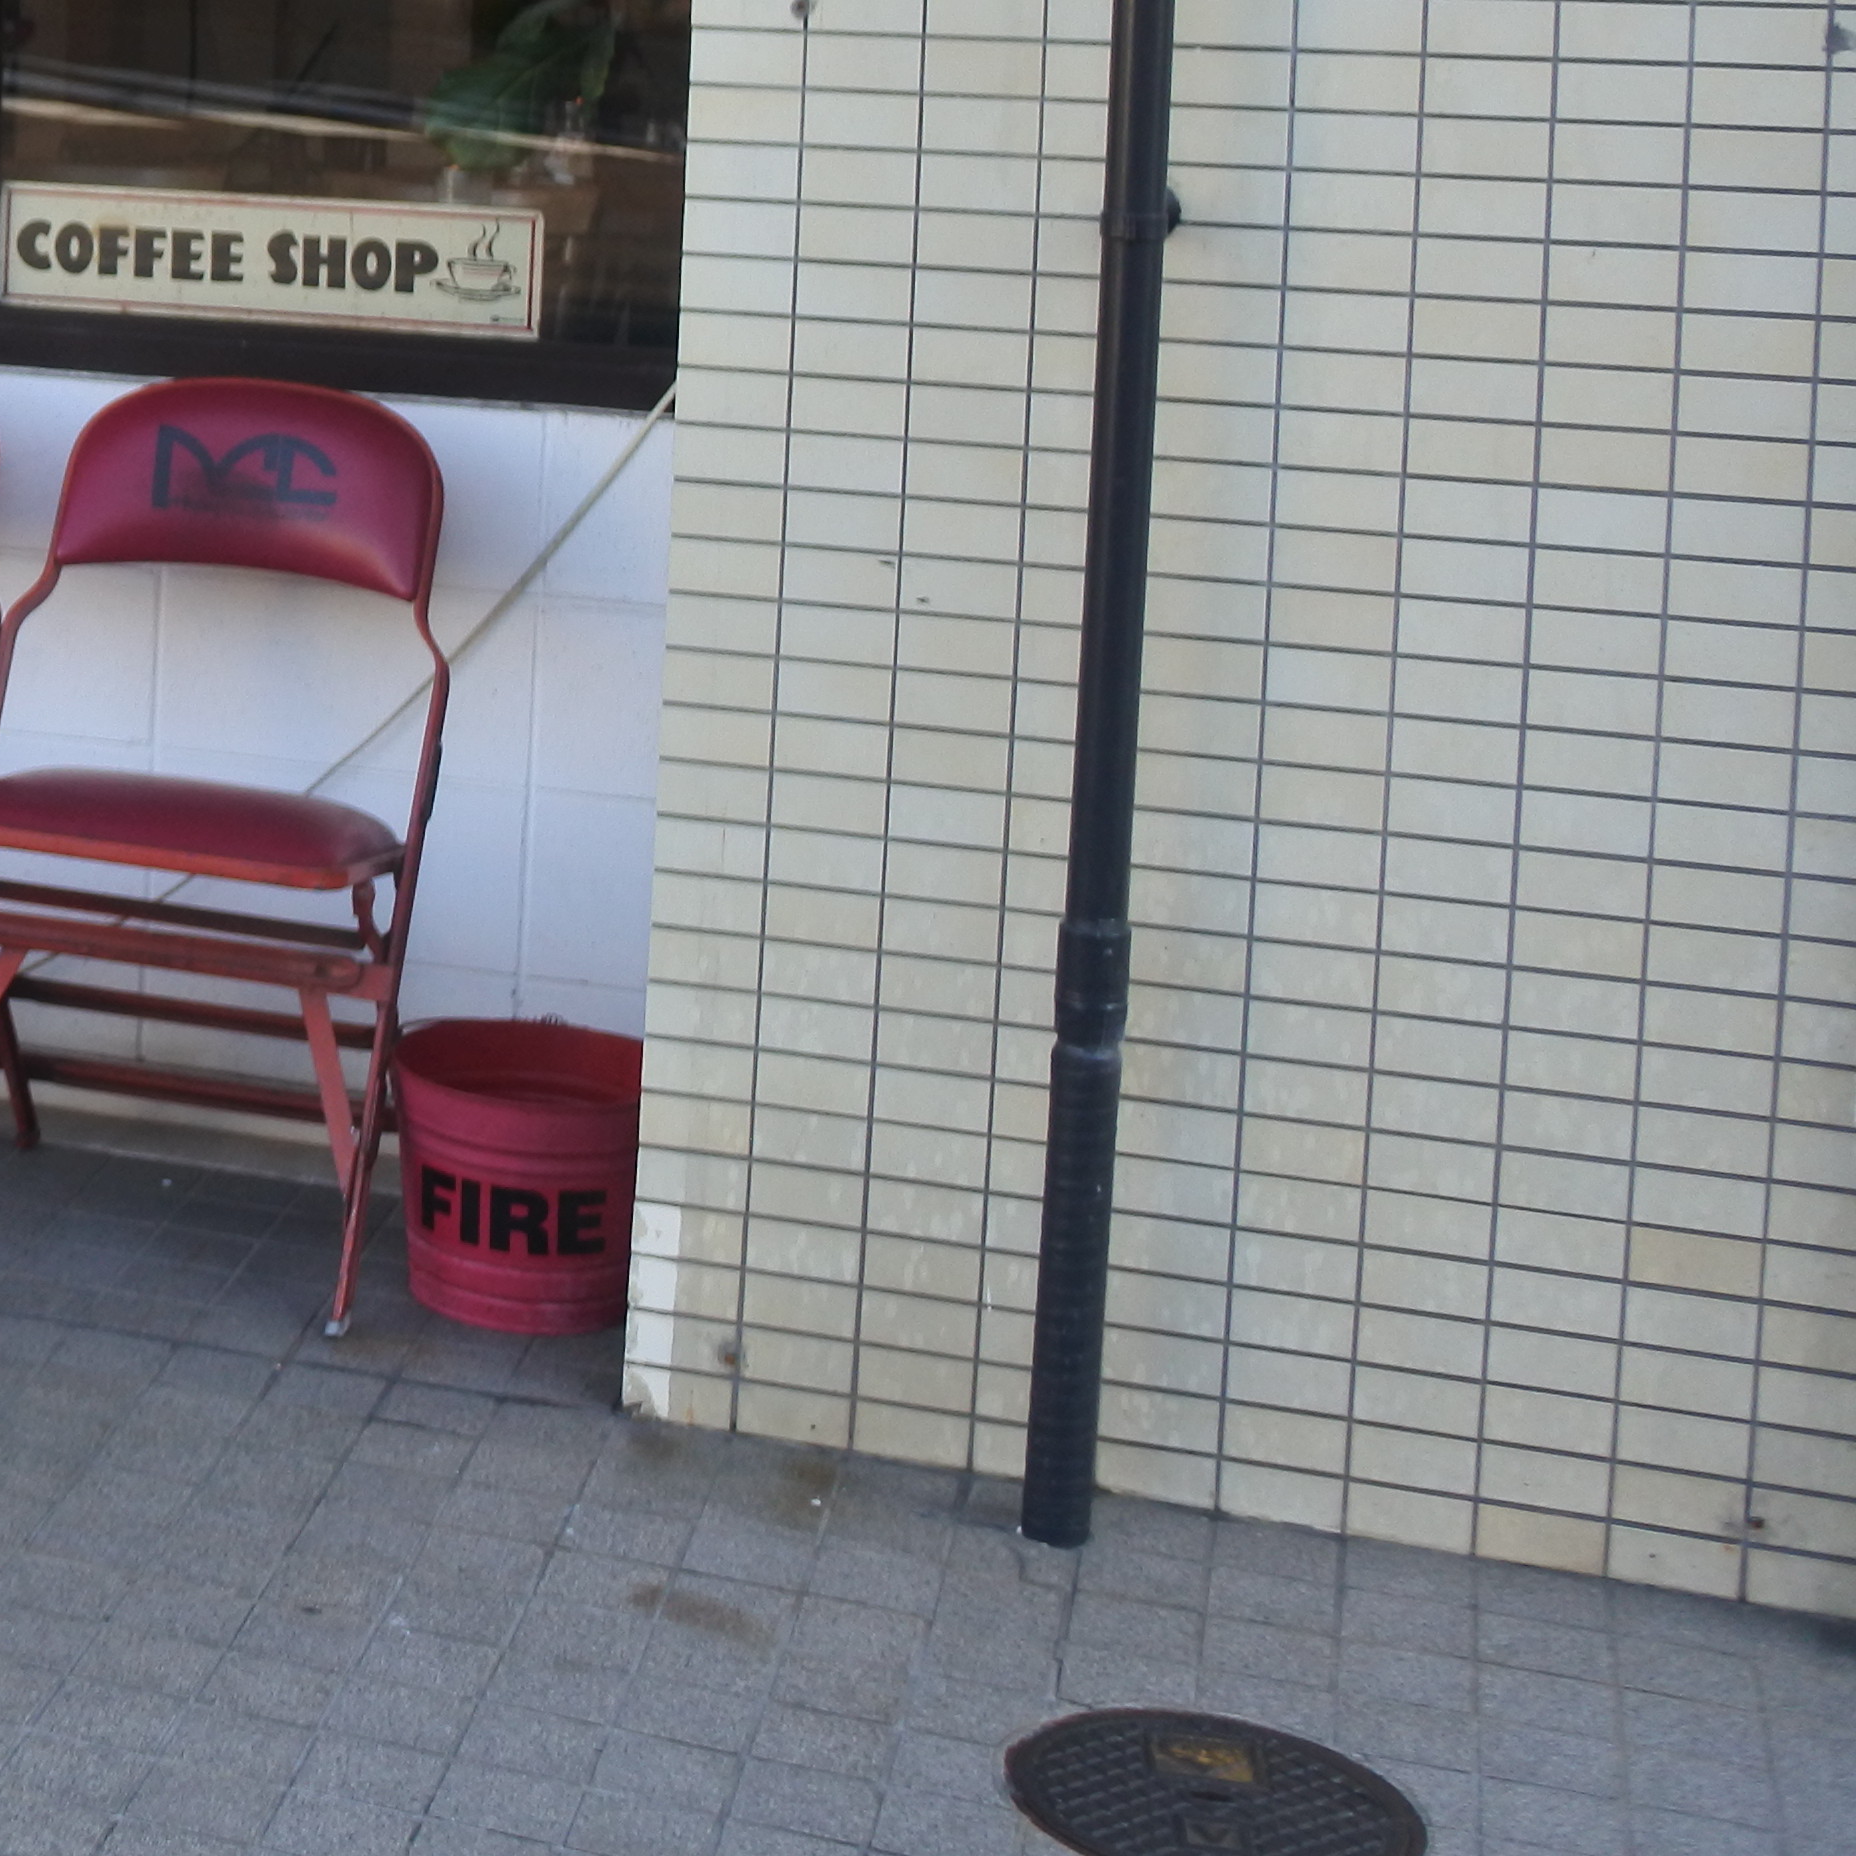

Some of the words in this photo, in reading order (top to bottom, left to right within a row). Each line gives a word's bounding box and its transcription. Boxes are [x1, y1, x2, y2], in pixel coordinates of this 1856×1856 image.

[15, 218, 245, 283] COFFEE
[267, 230, 440, 293] SHOP
[420, 1164, 608, 1257] FIRE
